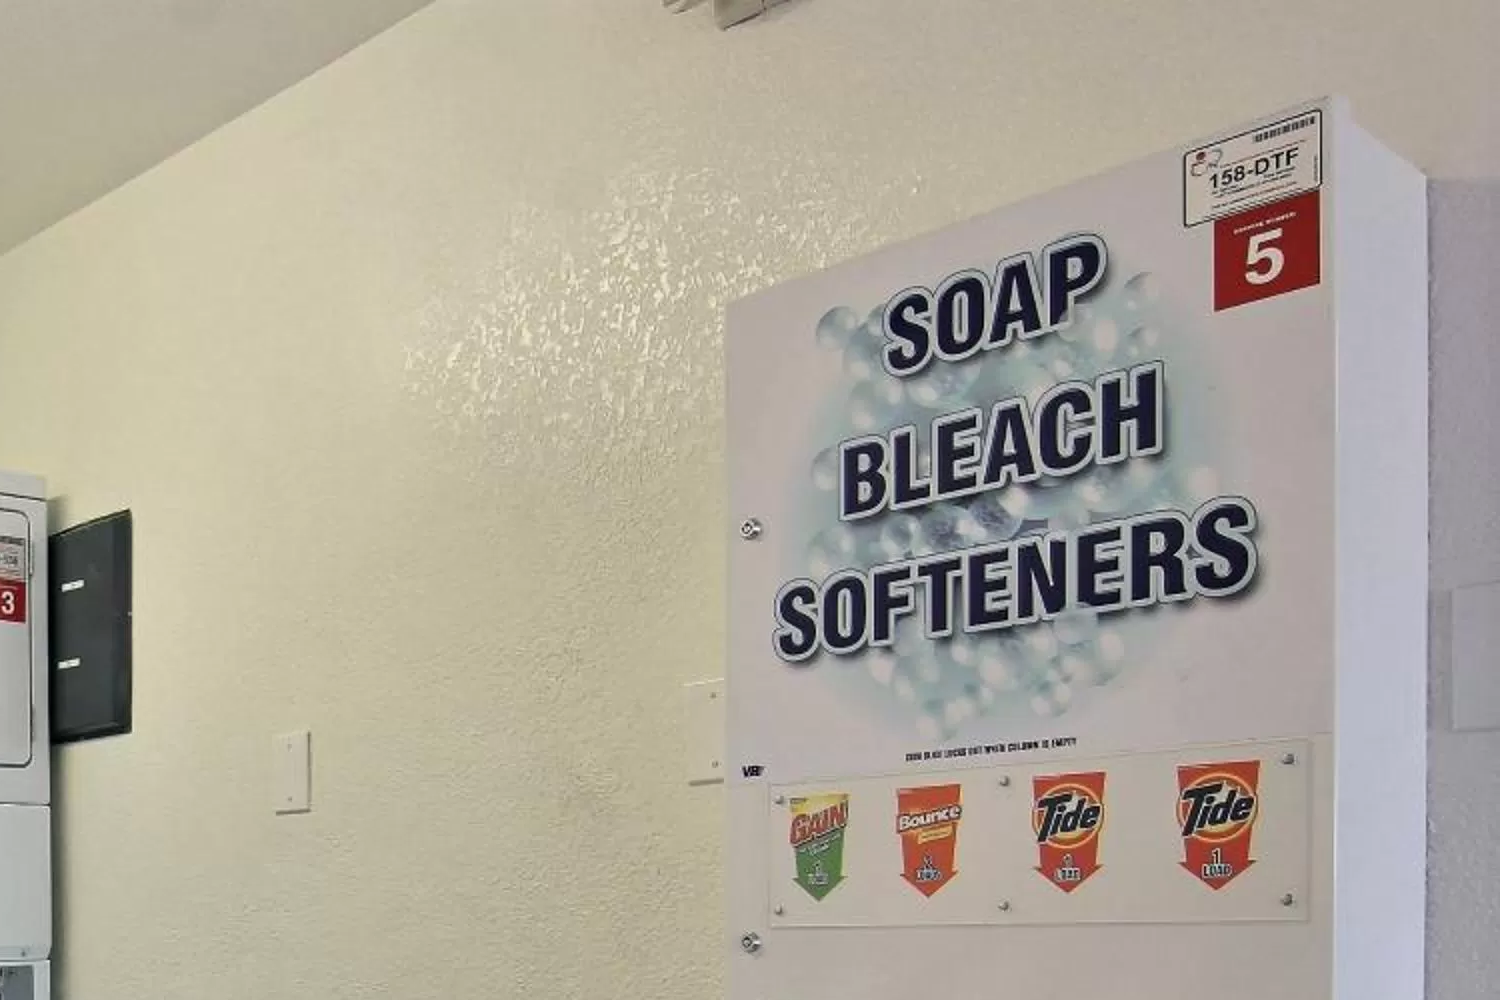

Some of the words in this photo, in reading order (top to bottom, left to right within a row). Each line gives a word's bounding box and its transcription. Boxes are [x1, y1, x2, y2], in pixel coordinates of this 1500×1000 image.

[1209, 147, 1299, 188] 158-DTF
[1245, 227, 1285, 285] 5
[883, 233, 1108, 377] SOAP
[838, 360, 1164, 521] BLEACH
[1, 591, 15, 614] 3
[773, 496, 1258, 662] SOFTENERS
[899, 805, 961, 831] Bounce
[1037, 792, 1101, 843] Tide
[1182, 780, 1254, 837] Tide
